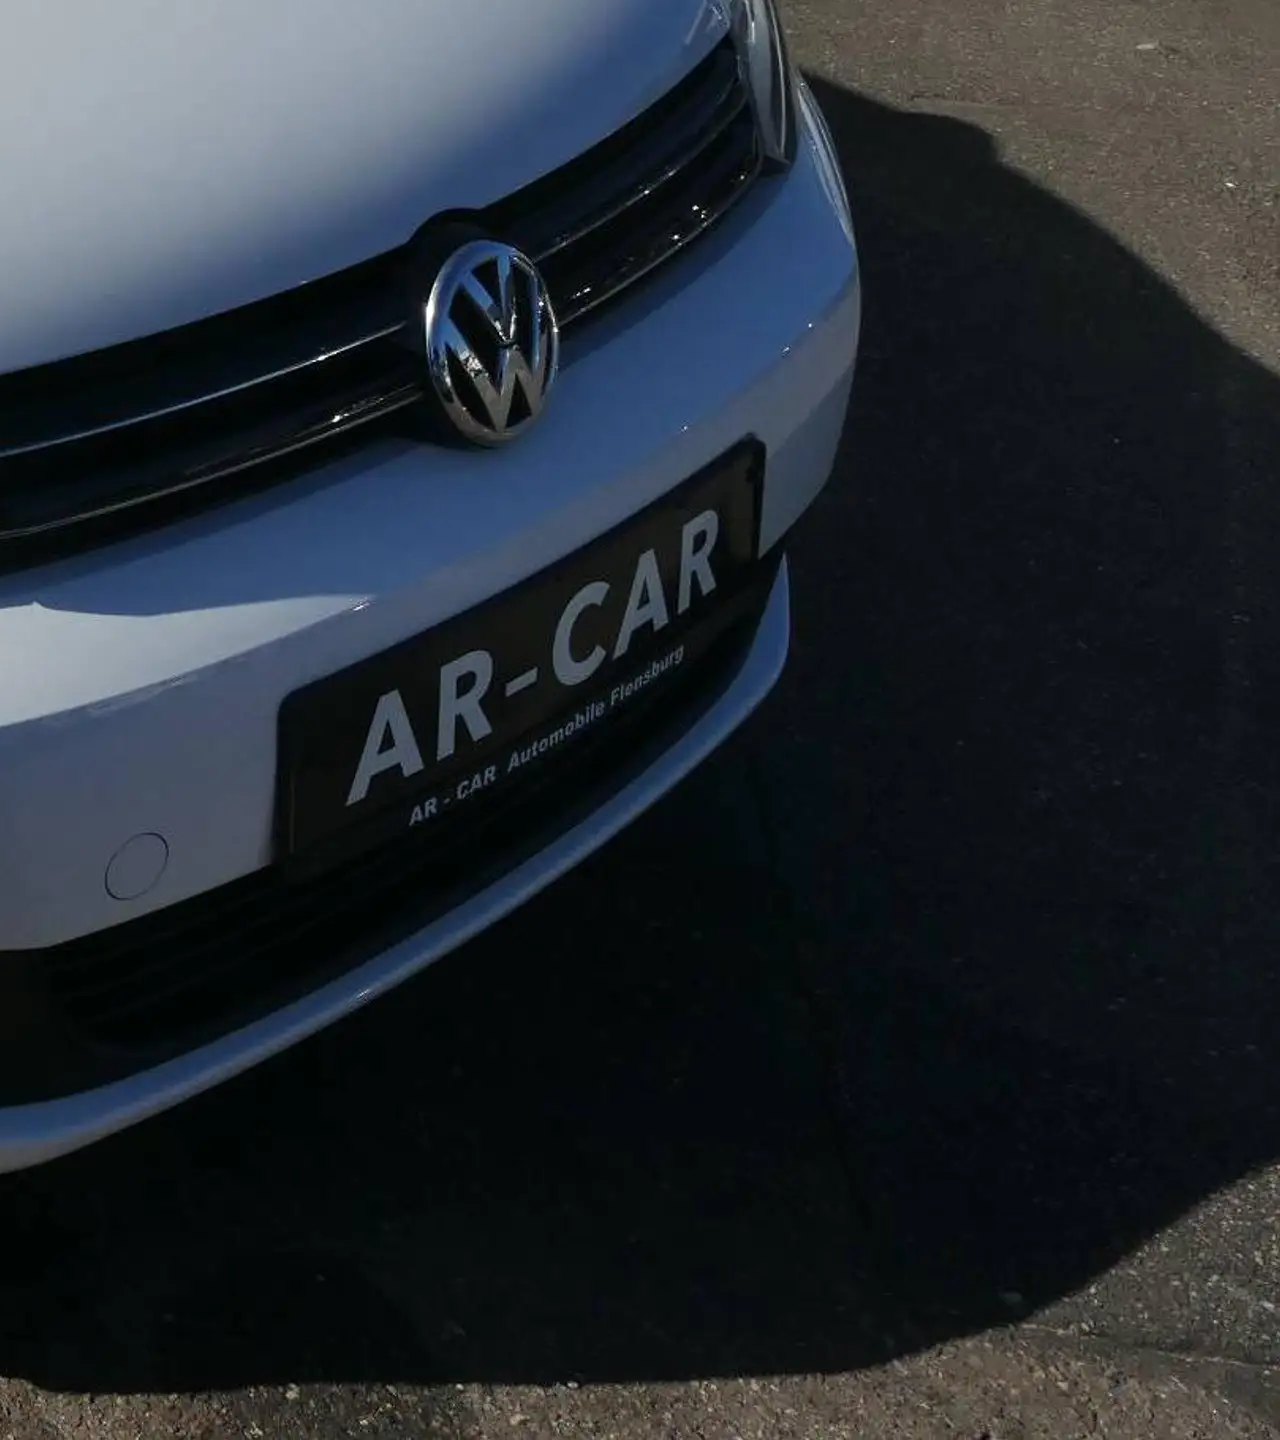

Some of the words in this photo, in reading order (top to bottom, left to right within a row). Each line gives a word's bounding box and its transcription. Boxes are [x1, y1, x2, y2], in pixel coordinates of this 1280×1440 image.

[425, 240, 559, 447] VW
[345, 509, 719, 807] AR-CAR
[408, 796, 438, 826] AR
[456, 764, 497, 800] CAR
[506, 700, 606, 773] Automobile
[609, 644, 685, 706] Flensburg
